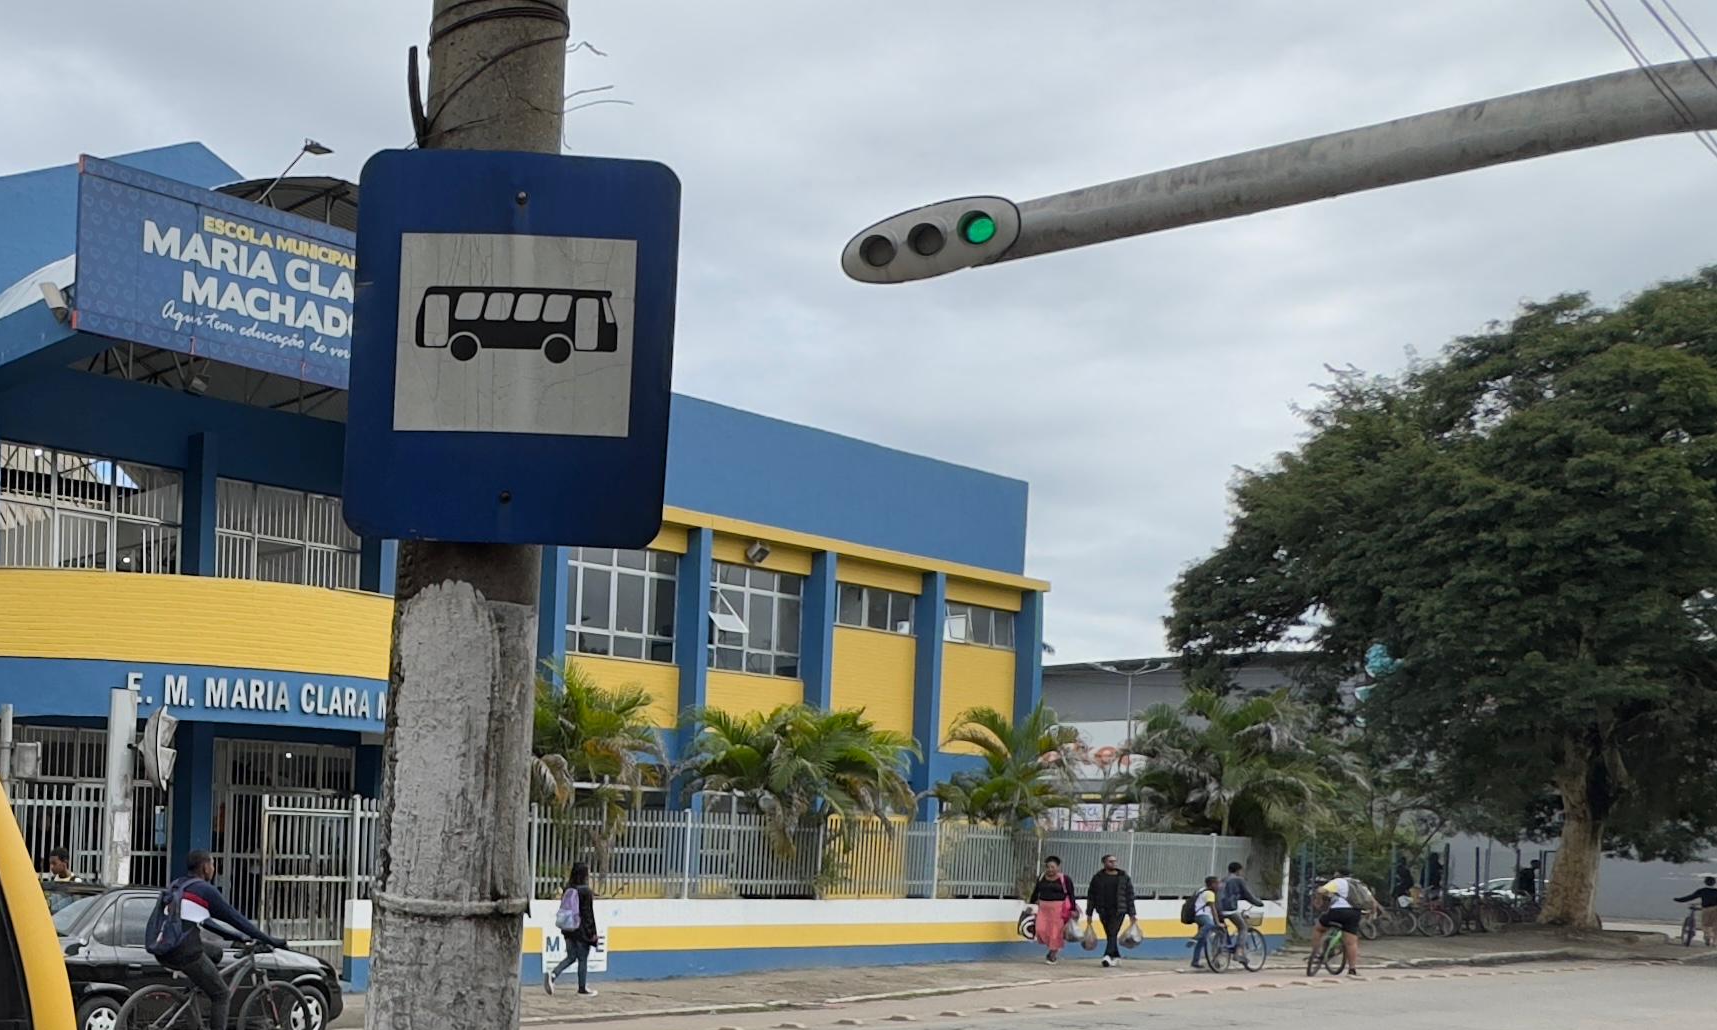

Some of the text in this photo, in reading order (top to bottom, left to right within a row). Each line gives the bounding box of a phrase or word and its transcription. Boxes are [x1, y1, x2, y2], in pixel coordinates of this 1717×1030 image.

[143, 219, 278, 285] MARIA
[203, 216, 274, 249] ESCOLA
[161, 299, 203, 331] Aqui
[202, 313, 235, 334] tem
[239, 321, 305, 349] educação
[164, 673, 195, 707] M.
[205, 676, 291, 712] MARIA
[300, 682, 371, 719] CLARA
